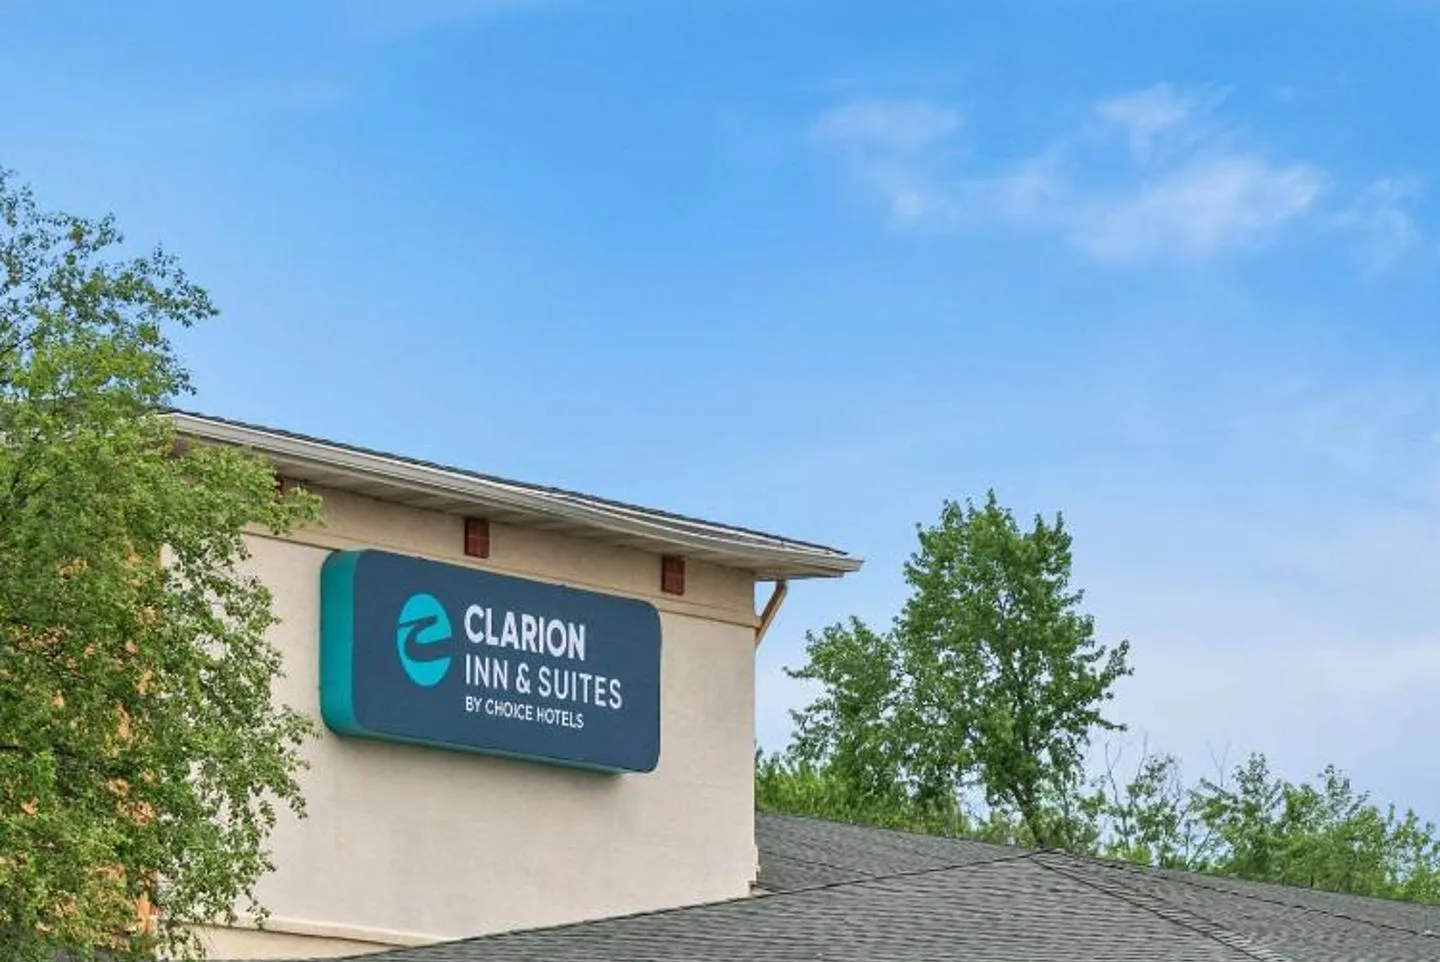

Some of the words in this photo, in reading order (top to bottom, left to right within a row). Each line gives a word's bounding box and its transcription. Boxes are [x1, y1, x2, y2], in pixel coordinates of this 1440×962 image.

[464, 603, 587, 662] CLARION
[464, 653, 508, 691] INN
[515, 663, 532, 695] &
[538, 665, 623, 710] SUITES
[465, 696, 483, 714] BY
[485, 700, 533, 722] CHOICE
[536, 707, 585, 729] HOTELS
